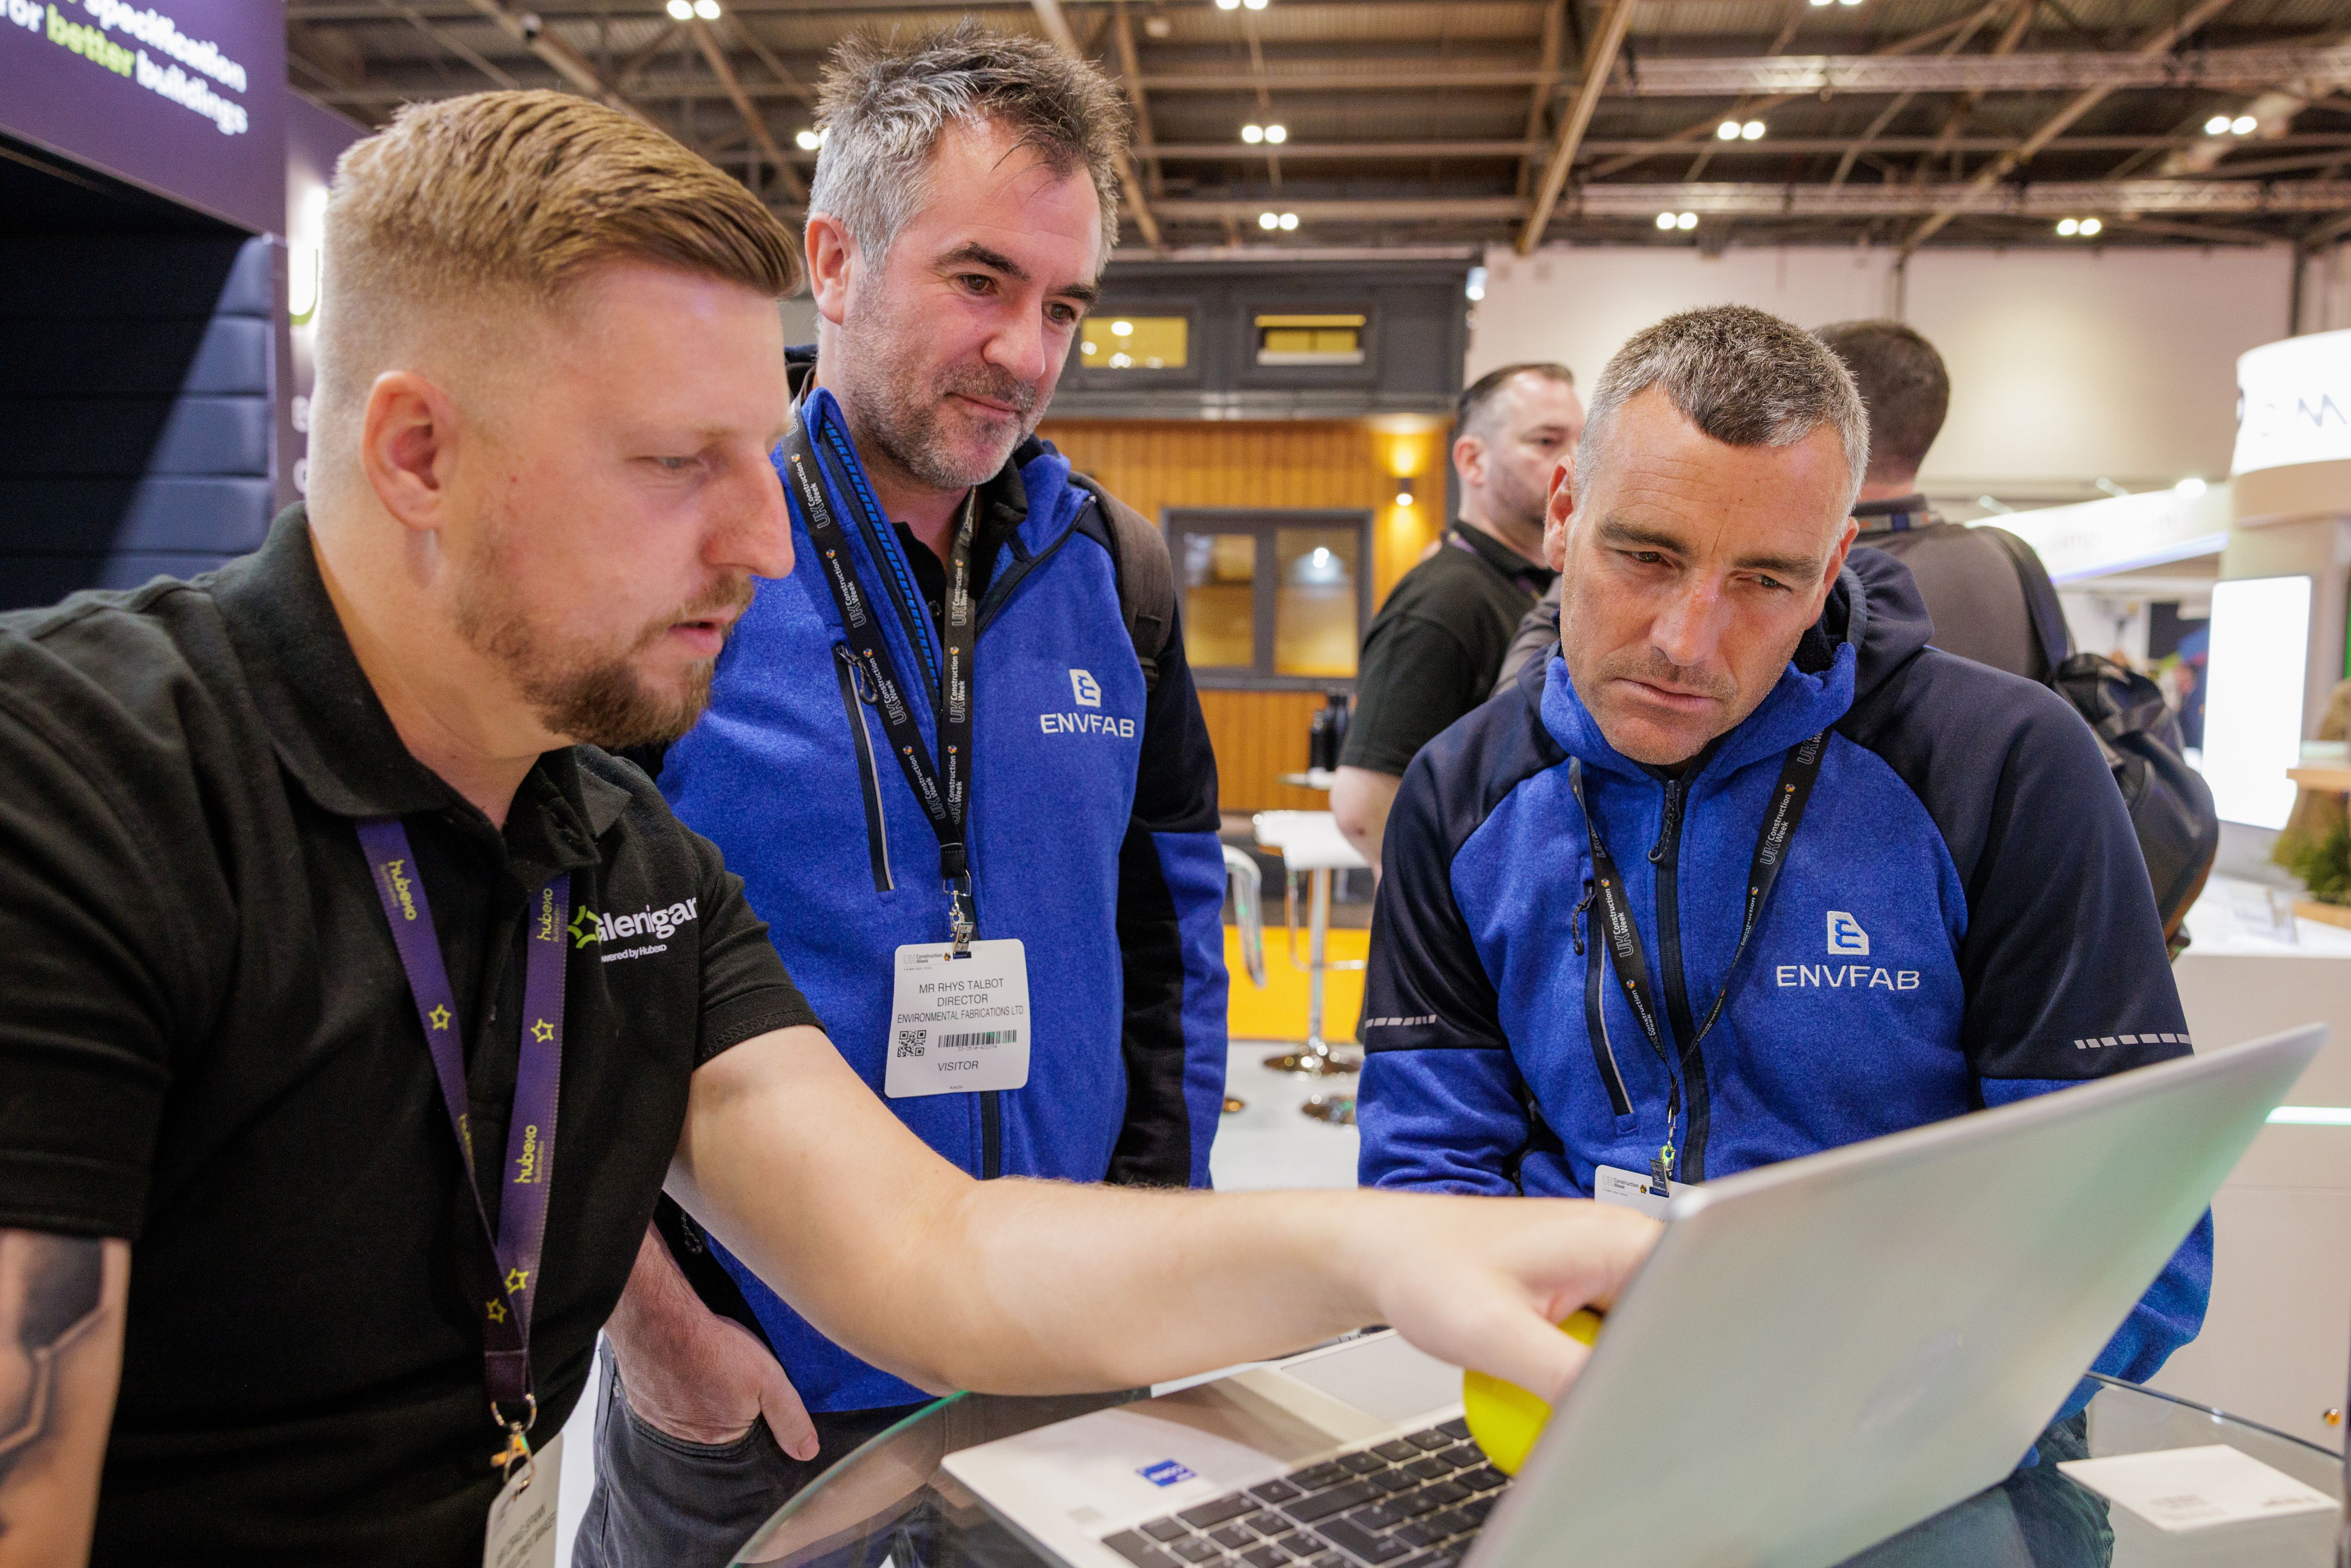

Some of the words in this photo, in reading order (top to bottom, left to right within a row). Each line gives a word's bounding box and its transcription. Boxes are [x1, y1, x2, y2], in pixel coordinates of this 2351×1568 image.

[47, 3, 136, 78] better
[136, 49, 248, 135] buildings
[796, 462, 815, 507] Construction
[810, 482, 822, 504] Week
[810, 503, 830, 529] UK
[832, 559, 852, 606] Construction
[847, 581, 859, 604] Week
[847, 602, 867, 628] UK
[870, 658, 891, 704] Construction
[886, 679, 898, 702] Week
[886, 700, 907, 725] UK
[950, 700, 965, 723] UK
[1040, 712, 1135, 738] ENVFAB
[909, 755, 931, 799] Construction
[926, 777, 938, 798] Week
[927, 796, 946, 819] UK
[1767, 794, 1791, 841] Construction
[1775, 822, 1789, 842] Week
[1760, 840, 1781, 865] UK
[387, 859, 417, 920] hubexo
[536, 888, 553, 940] hubexo
[1605, 889, 1620, 935] Construction
[1620, 912, 1628, 933] Week
[629, 948, 639, 959] by
[639, 944, 667, 955] Hubexo
[1614, 933, 1634, 957] UK
[919, 984, 935, 993] MR
[938, 981, 964, 992] RHYS
[967, 978, 1004, 990] TALBOT
[1776, 964, 1920, 991] ENVFAB
[938, 994, 988, 1007] DIRECTOR
[898, 1011, 959, 1023] ENVIRONMENTAL
[961, 1006, 1010, 1019] FABRICATIONS
[1011, 1005, 1024, 1015] LTD
[938, 1061, 978, 1071] VISITOR
[513, 1125, 537, 1183] hubexo
[1614, 1178, 1639, 1188] Construction
